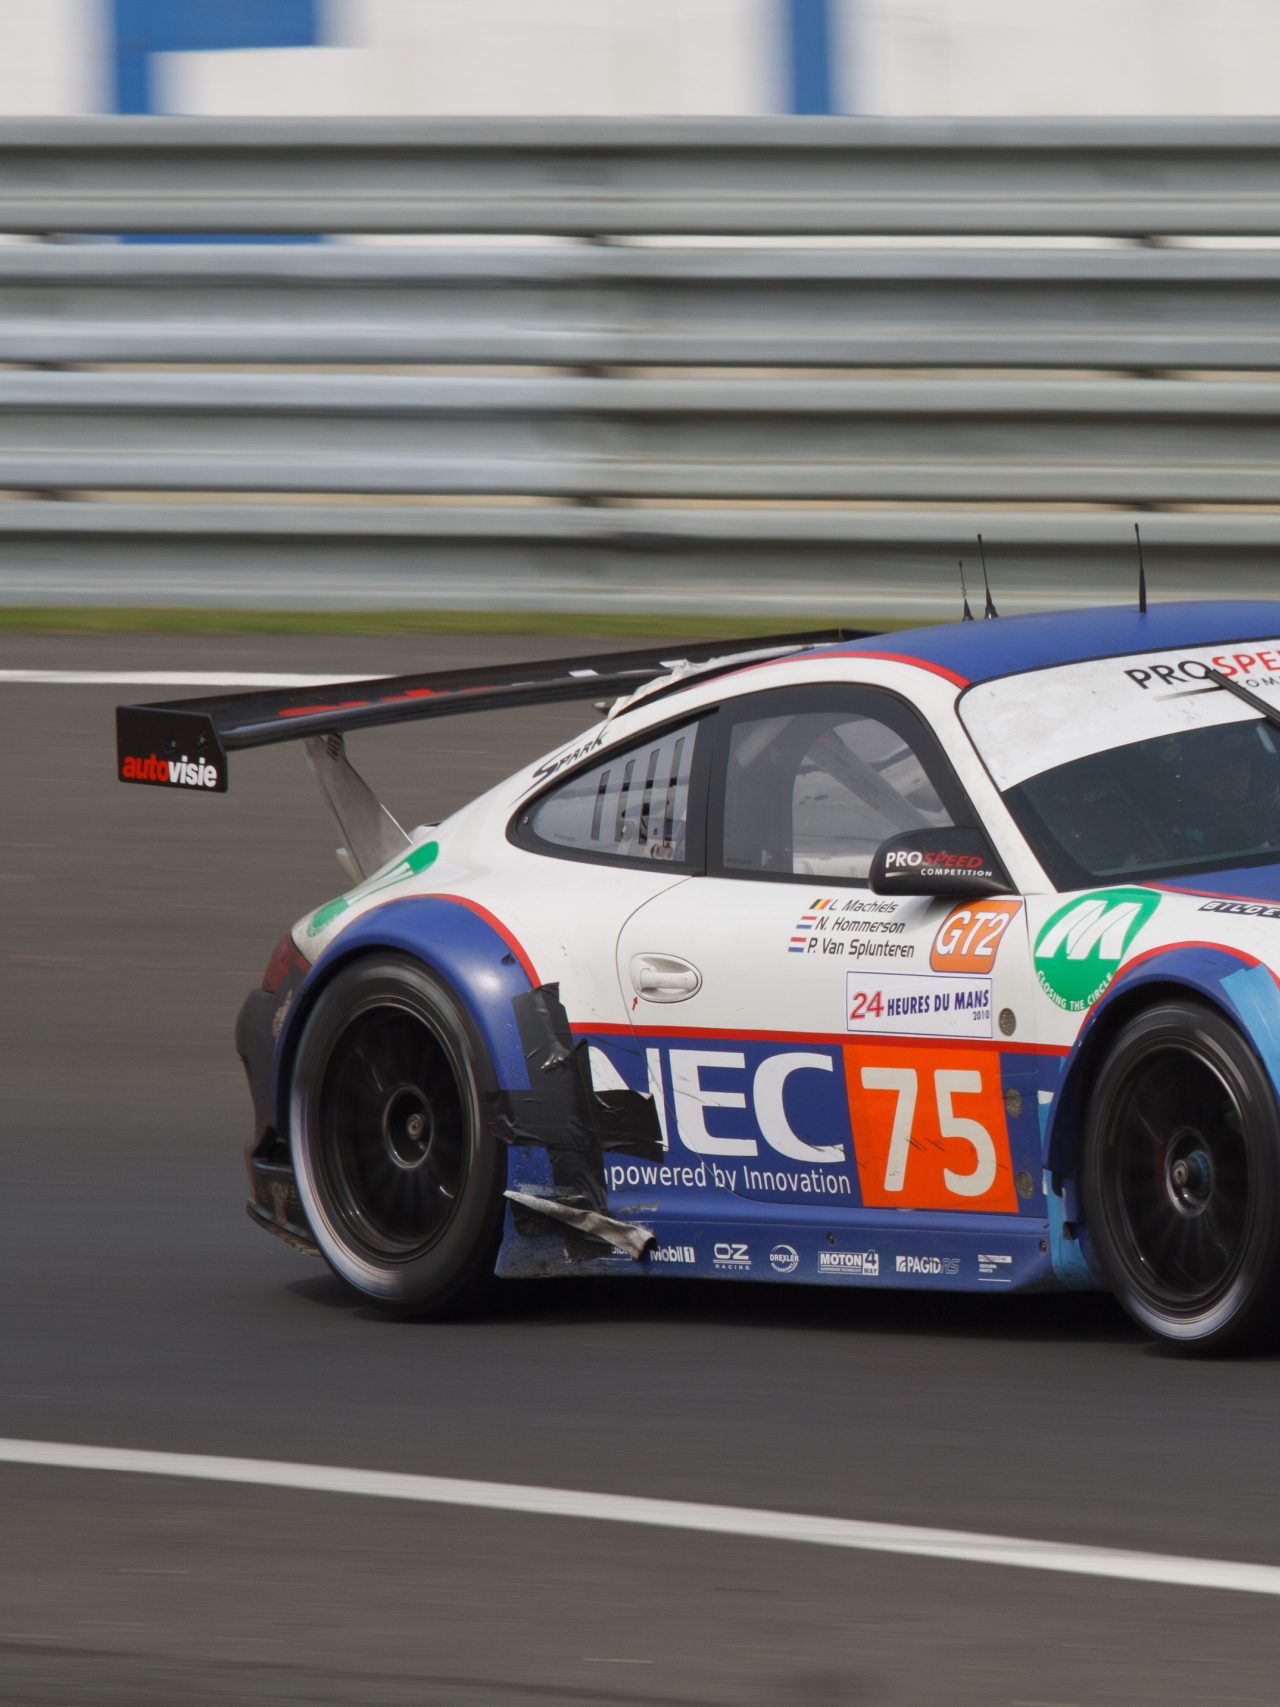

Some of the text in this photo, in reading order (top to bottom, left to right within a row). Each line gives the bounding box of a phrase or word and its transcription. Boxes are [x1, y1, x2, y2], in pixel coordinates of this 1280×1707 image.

[122, 753, 218, 788] autovisie
[885, 851, 983, 868] PROSPEED
[921, 868, 992, 877] COMPETITION
[841, 899, 898, 913] Machiels
[815, 916, 905, 934] N. Hommerson
[936, 910, 1010, 956] GT2
[807, 937, 914, 959] P. Van Splunteren
[1037, 970, 1067, 1009] CLOSING
[1069, 999, 1085, 1011] THE
[850, 989, 989, 1020] 24 HEURES DU MANS
[972, 1010, 990, 1021] 2010
[861, 1066, 997, 1196] 75
[604, 1161, 851, 1195] powered by Innovation
[769, 1253, 799, 1263] DREXLER
[820, 1249, 877, 1266] MOTON 4
[863, 1267, 878, 1276] WAY
